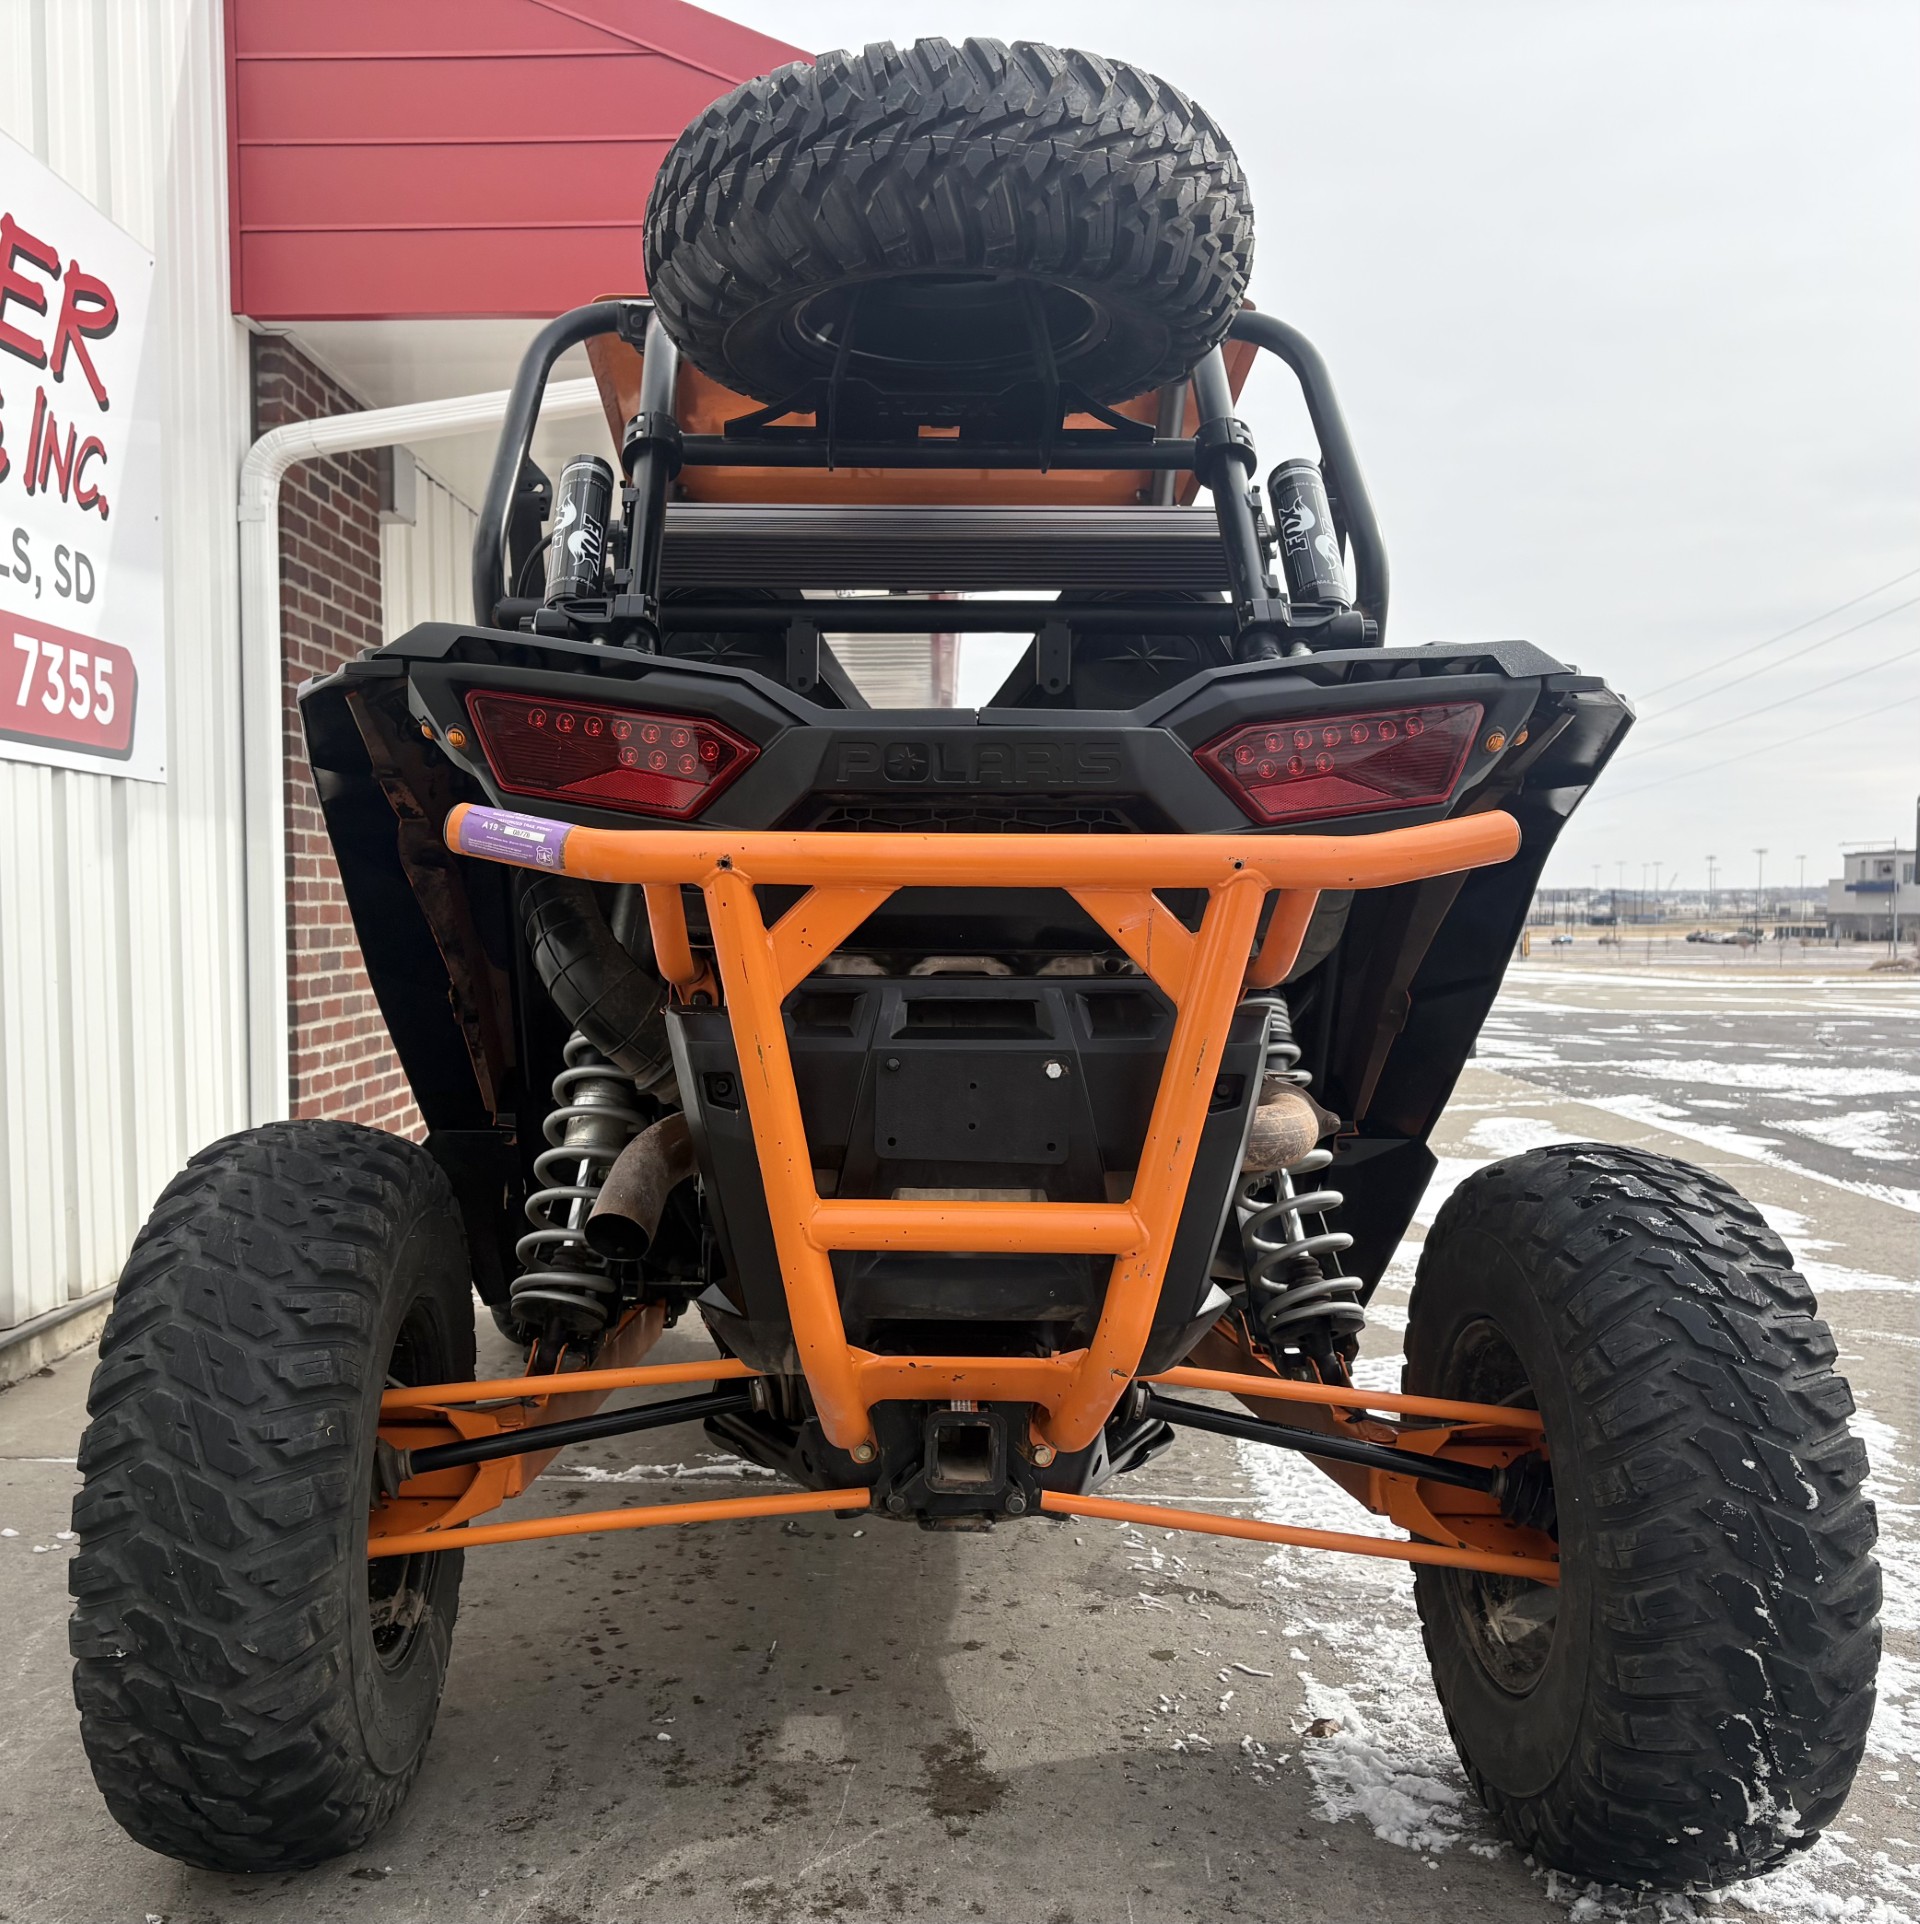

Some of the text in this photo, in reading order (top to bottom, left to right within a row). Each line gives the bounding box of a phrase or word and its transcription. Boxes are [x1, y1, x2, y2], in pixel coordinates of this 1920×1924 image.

[24, 385, 109, 521] INC.
[54, 544, 95, 604] SD
[13, 633, 115, 725] 7355
[836, 742, 1121, 783] POLARIS
